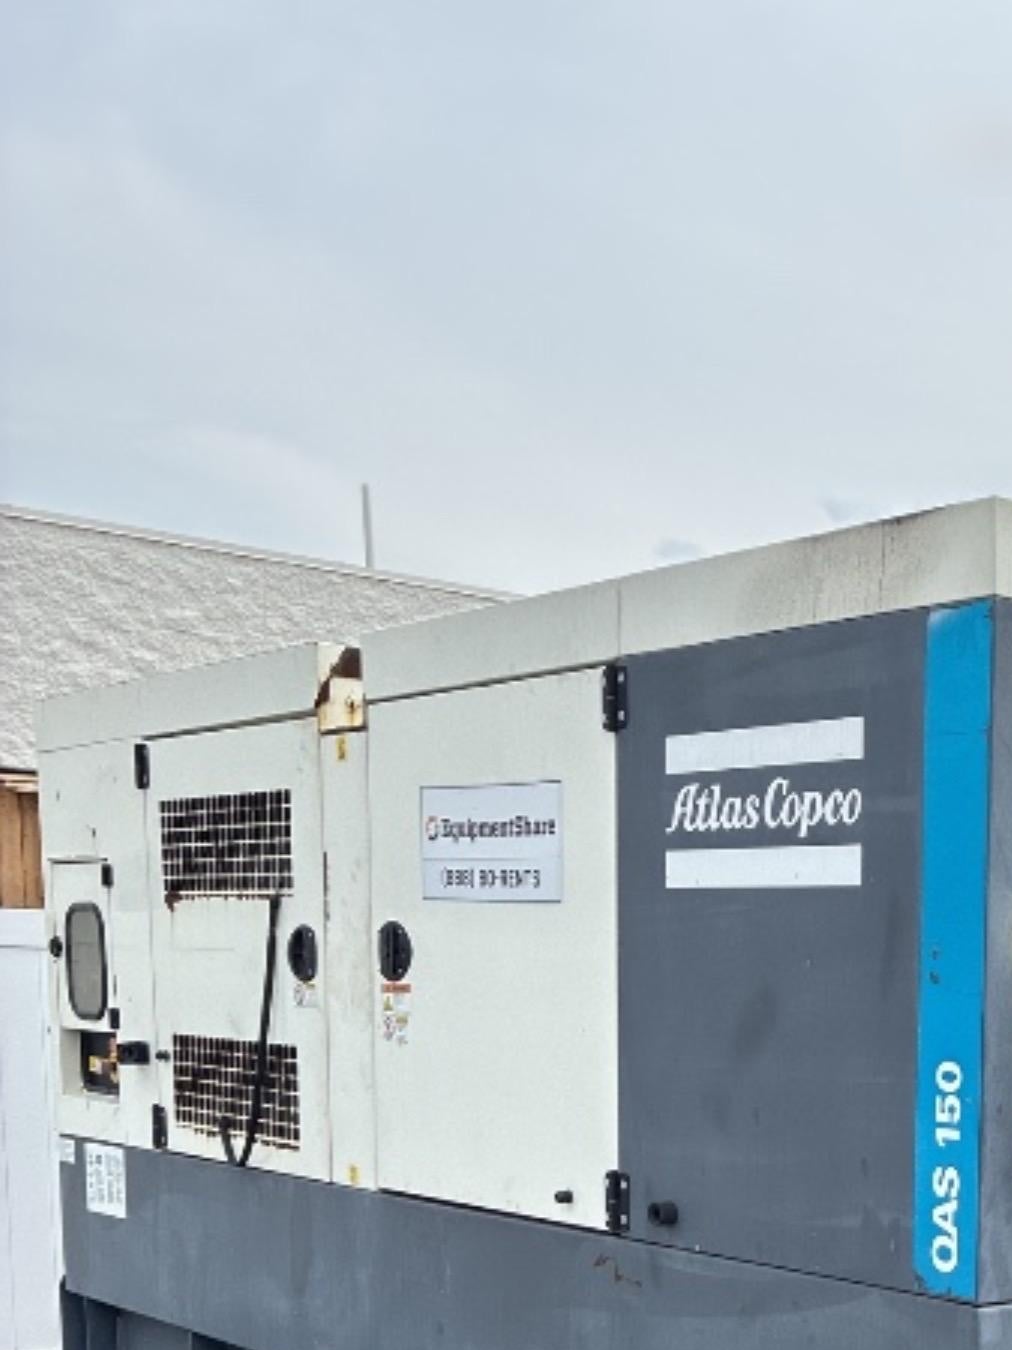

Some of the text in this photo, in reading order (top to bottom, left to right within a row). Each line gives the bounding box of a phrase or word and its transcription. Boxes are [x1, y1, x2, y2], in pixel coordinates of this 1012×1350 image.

[439, 815, 556, 843] EquipmentShare
[665, 776, 863, 838] Atlas Copco
[931, 1060, 963, 1274] QAS 150
